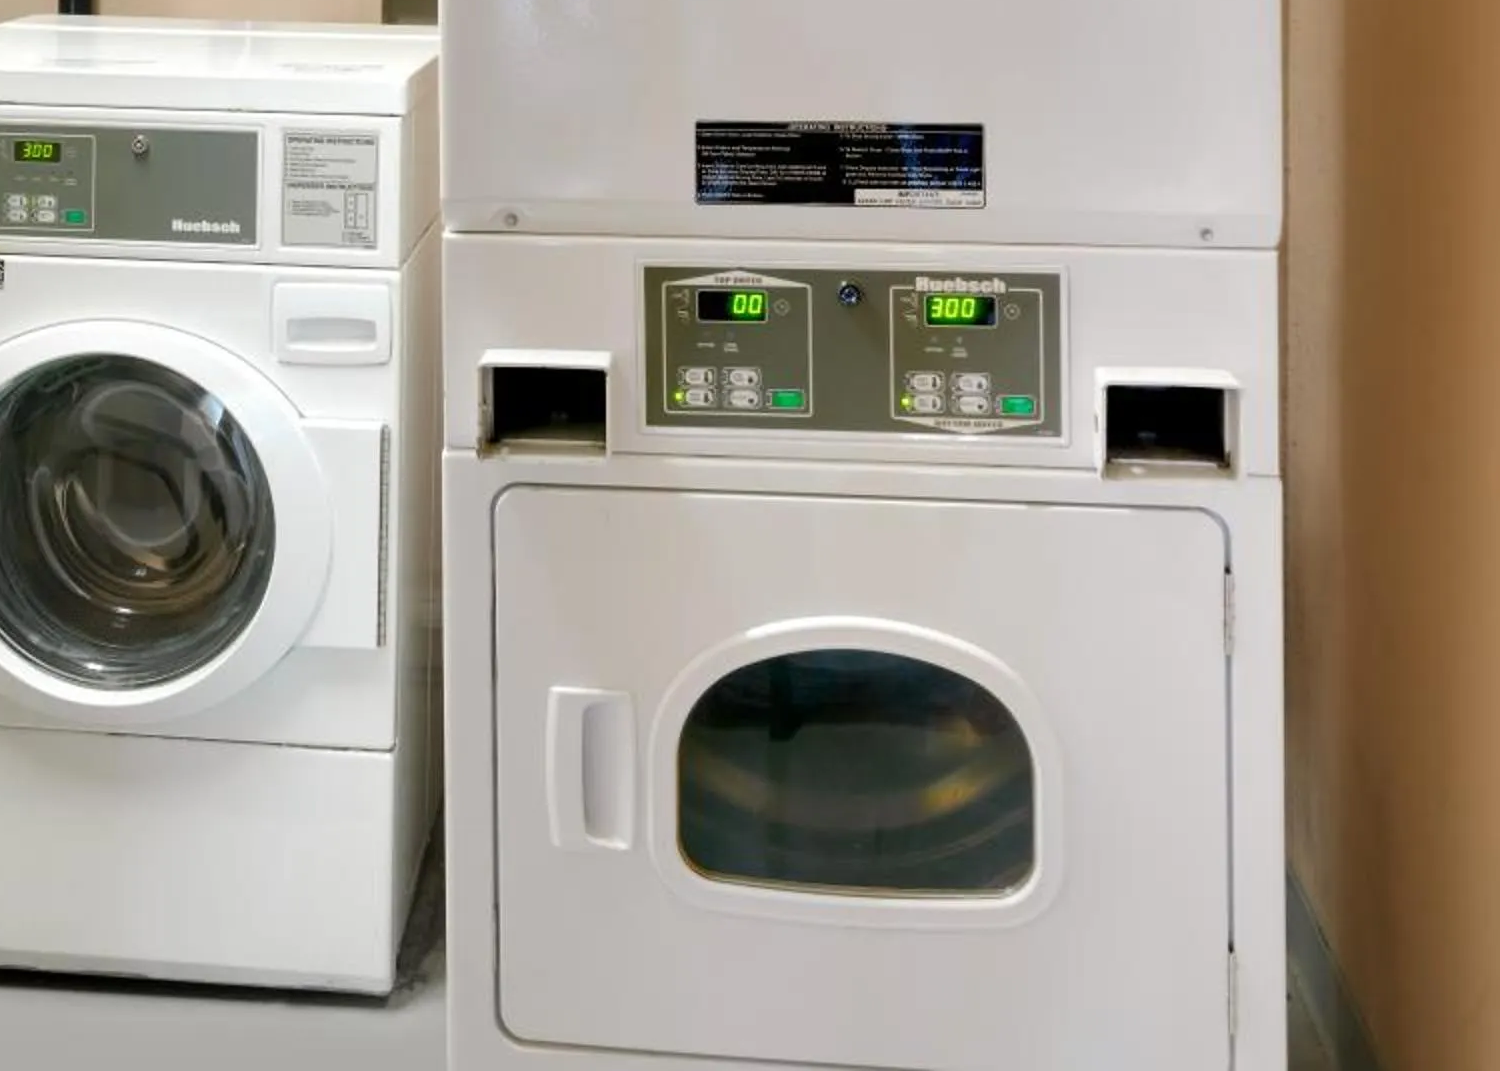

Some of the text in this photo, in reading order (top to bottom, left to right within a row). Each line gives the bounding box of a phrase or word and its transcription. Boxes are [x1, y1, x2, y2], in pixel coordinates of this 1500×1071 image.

[23, 143, 53, 158] 300
[171, 218, 240, 234] Huebsch
[915, 276, 1007, 294] Huebsch
[733, 294, 763, 314] 00
[930, 297, 976, 319] 300
